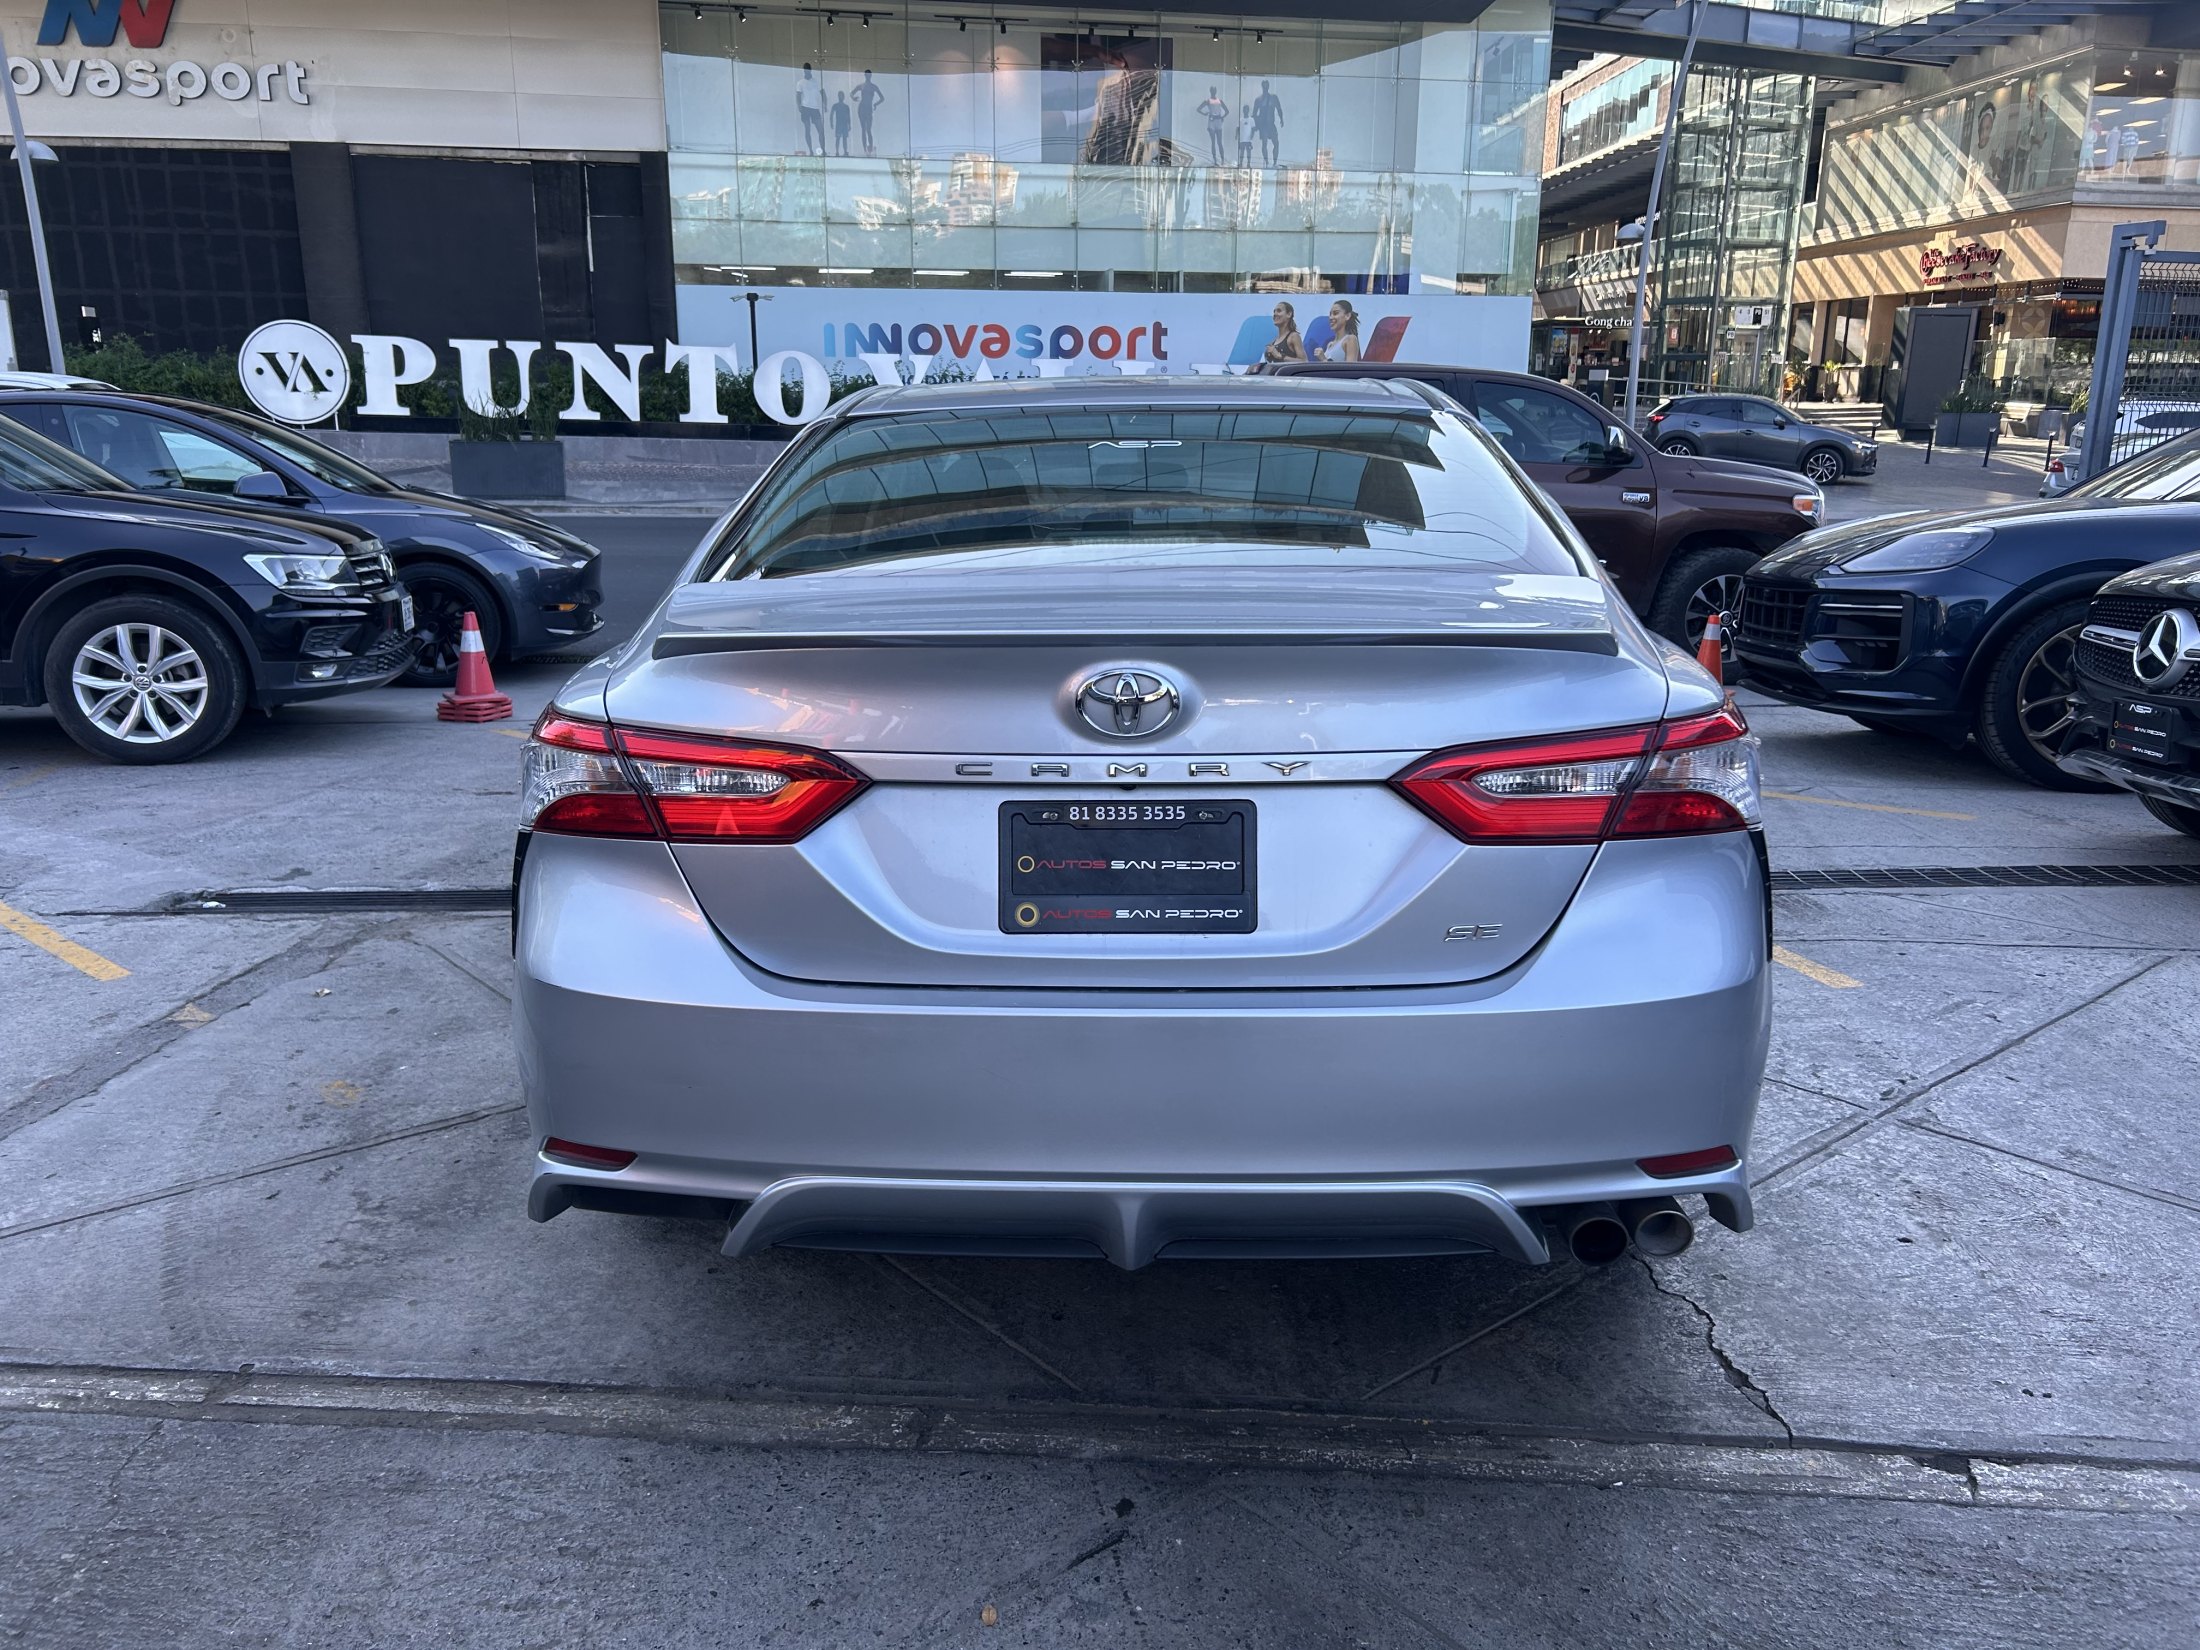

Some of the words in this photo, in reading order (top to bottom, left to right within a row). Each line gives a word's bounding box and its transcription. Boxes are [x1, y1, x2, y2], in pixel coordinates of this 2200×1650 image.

[1585, 316, 1613, 329] Gong
[1614, 316, 1633, 327] cha
[351, 334, 831, 426] PUNTO
[1088, 440, 1183, 449] ASP
[2129, 704, 2153, 713] ASP
[955, 761, 1311, 778] CAMRY
[1069, 806, 1091, 821] 81
[1095, 806, 1138, 821] 8335
[1143, 805, 1186, 821] 3535
[1036, 859, 1107, 870] AUTOS
[1110, 860, 1156, 870] SAN
[1042, 909, 1112, 919] AUTOS
[1115, 909, 1161, 919] SAN
[1443, 923, 1504, 942] SE
